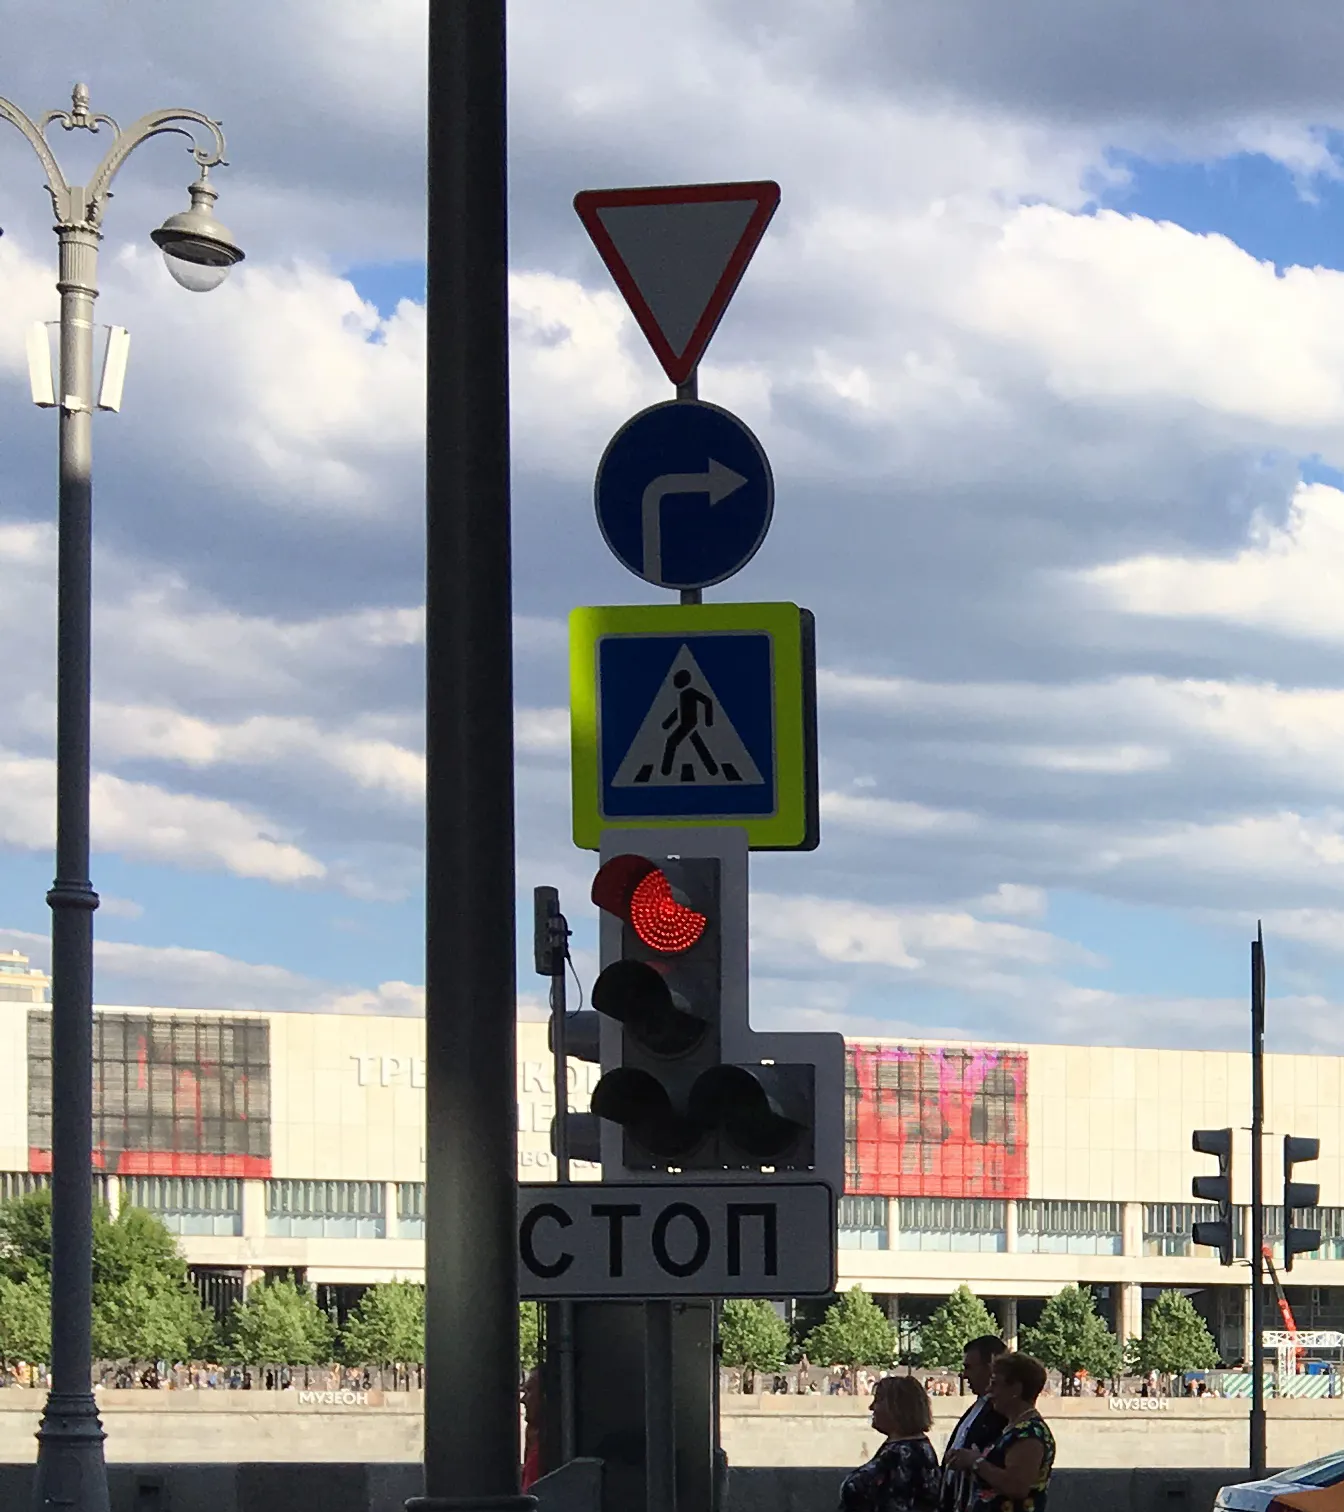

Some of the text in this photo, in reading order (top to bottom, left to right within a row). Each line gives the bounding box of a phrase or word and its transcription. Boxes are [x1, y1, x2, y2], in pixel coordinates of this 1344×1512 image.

[519, 1202, 778, 1278] СТОП
[299, 1390, 369, 1405] МУЗЕОН
[1109, 1397, 1170, 1410] МУЗЕОН
